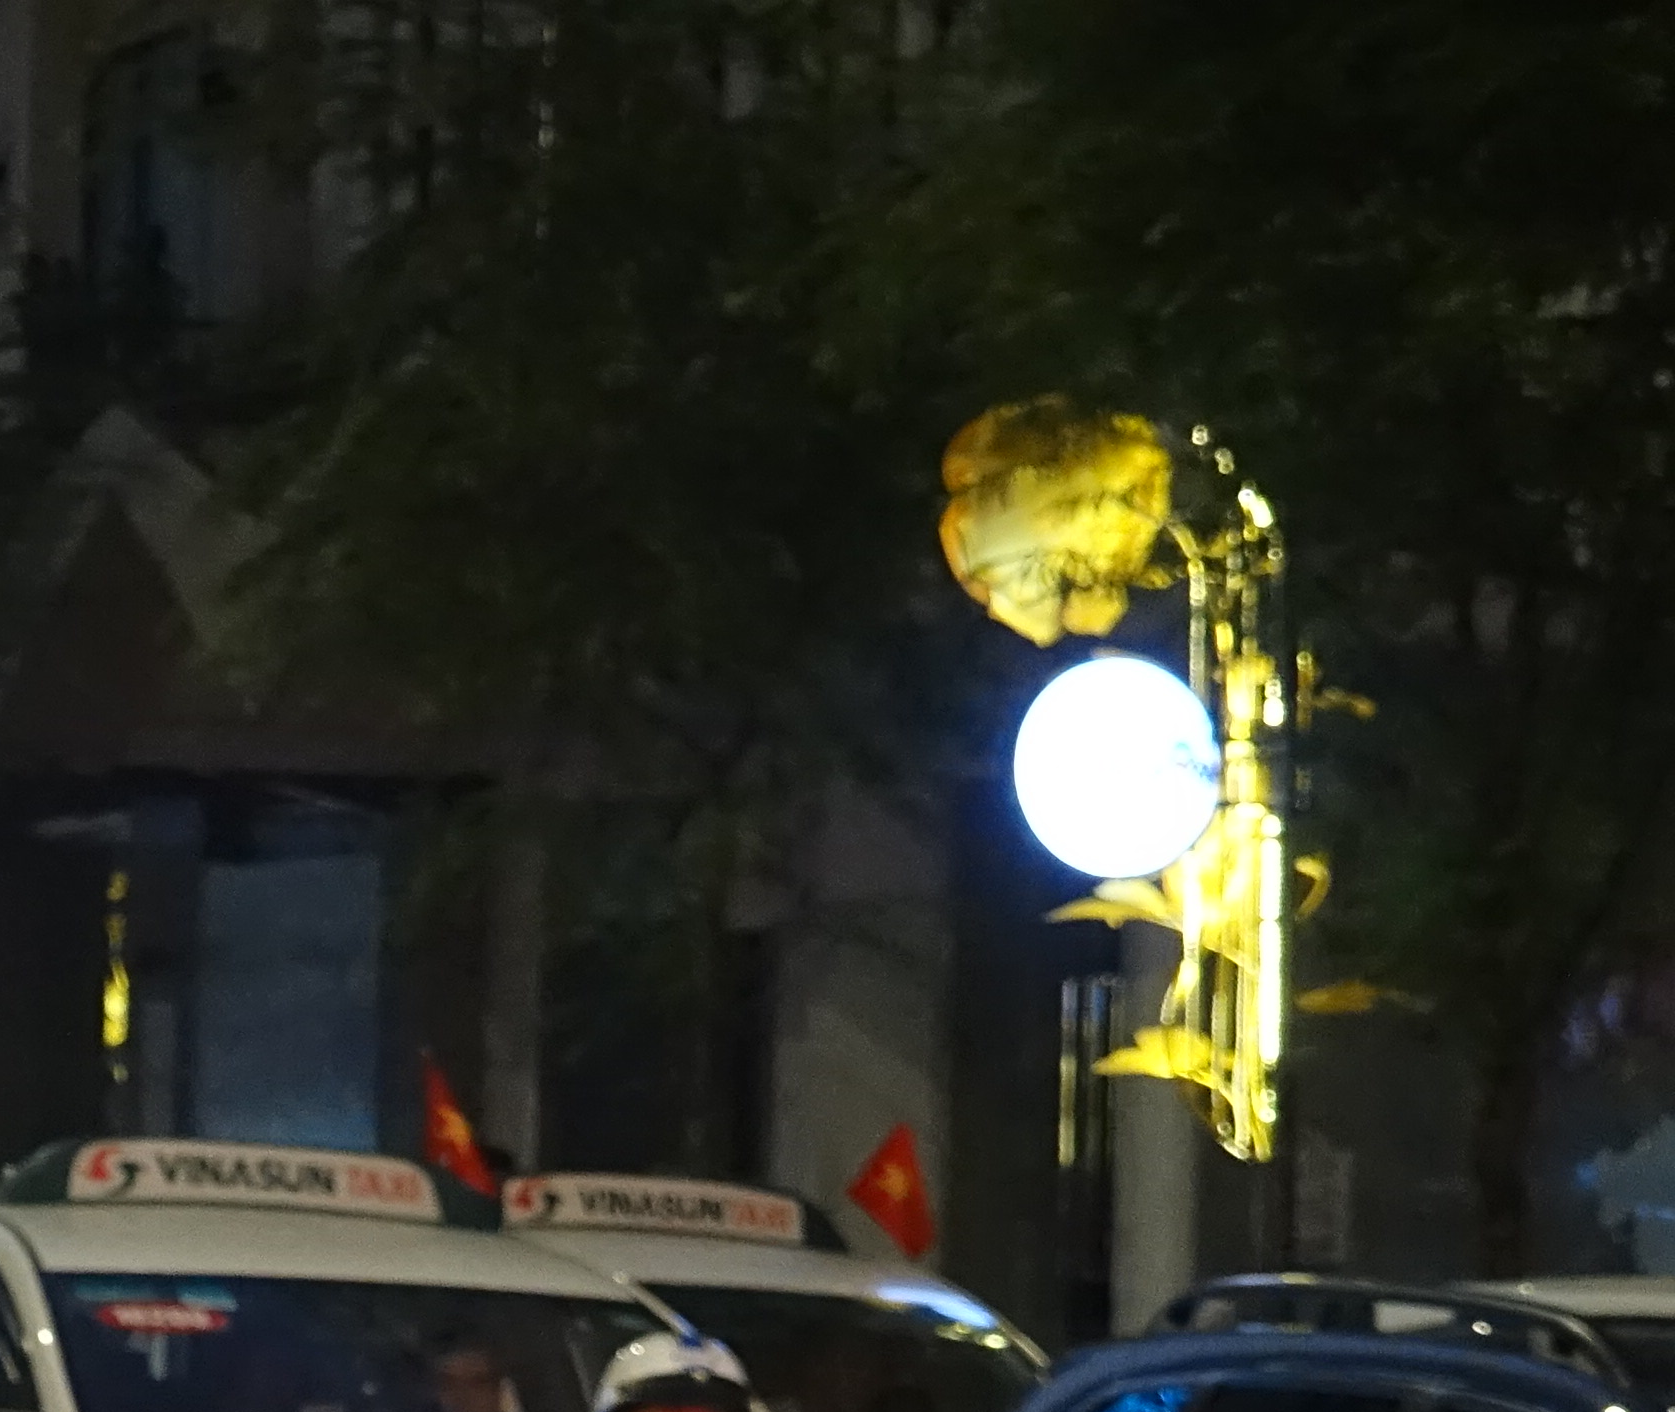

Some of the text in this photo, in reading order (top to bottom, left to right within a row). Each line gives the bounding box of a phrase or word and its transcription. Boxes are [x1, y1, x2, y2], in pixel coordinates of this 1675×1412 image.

[154, 1151, 421, 1205] VINASUN TAXI
[579, 1187, 724, 1224] VINASUN
